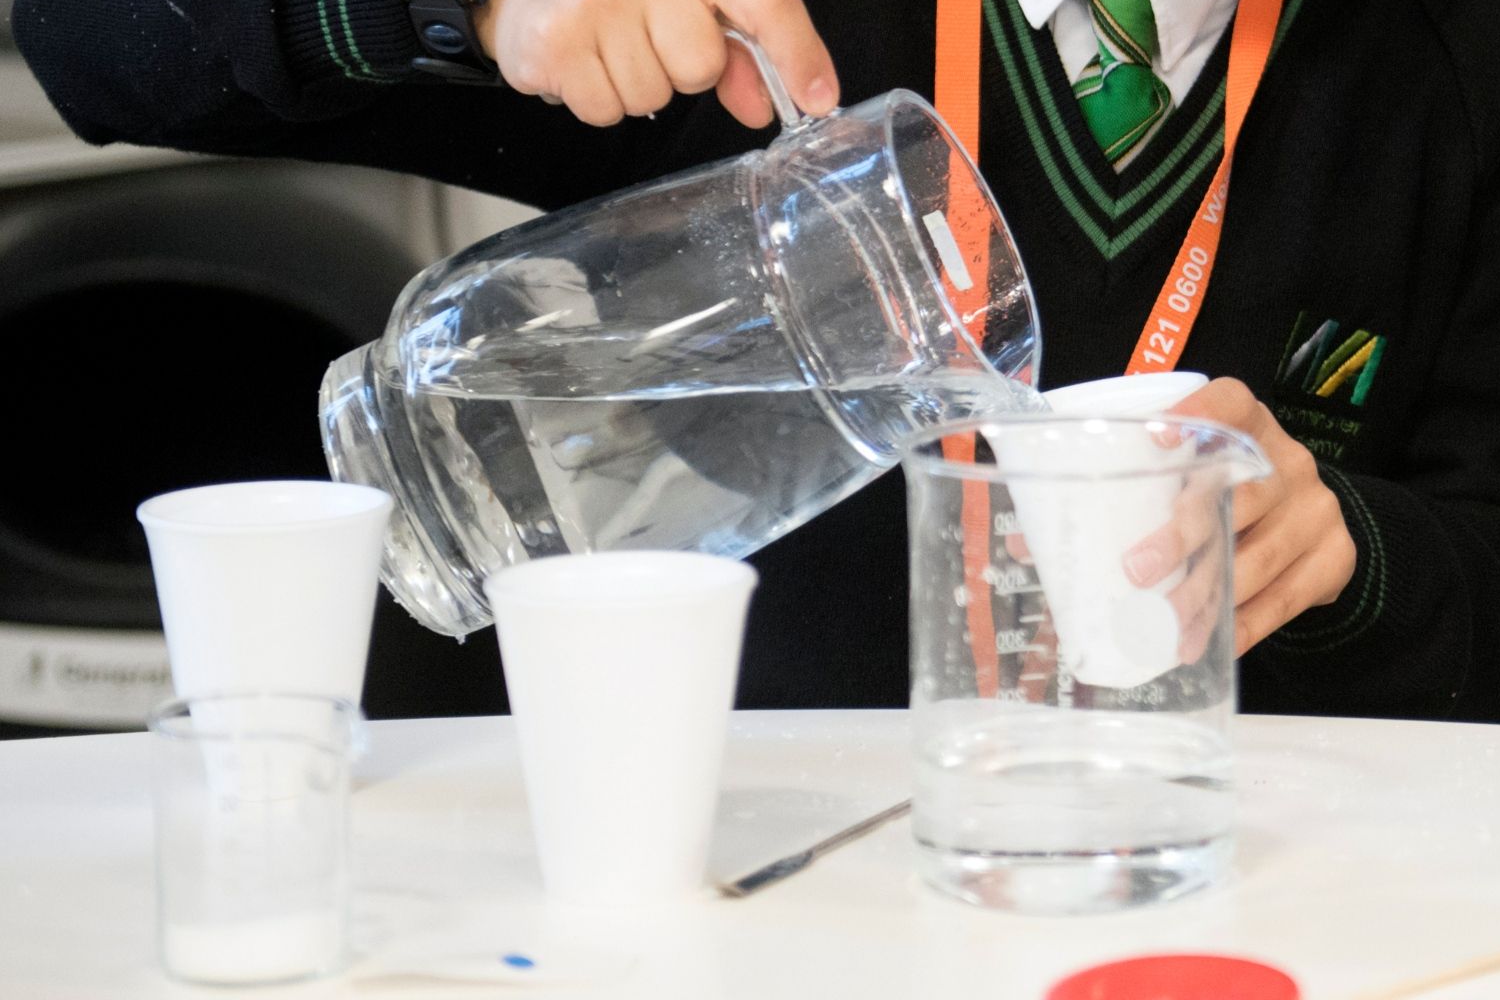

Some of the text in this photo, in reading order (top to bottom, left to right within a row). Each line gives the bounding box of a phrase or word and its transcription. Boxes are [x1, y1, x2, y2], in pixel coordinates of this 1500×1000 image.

[1143, 174, 1230, 365] 121 0600 We
